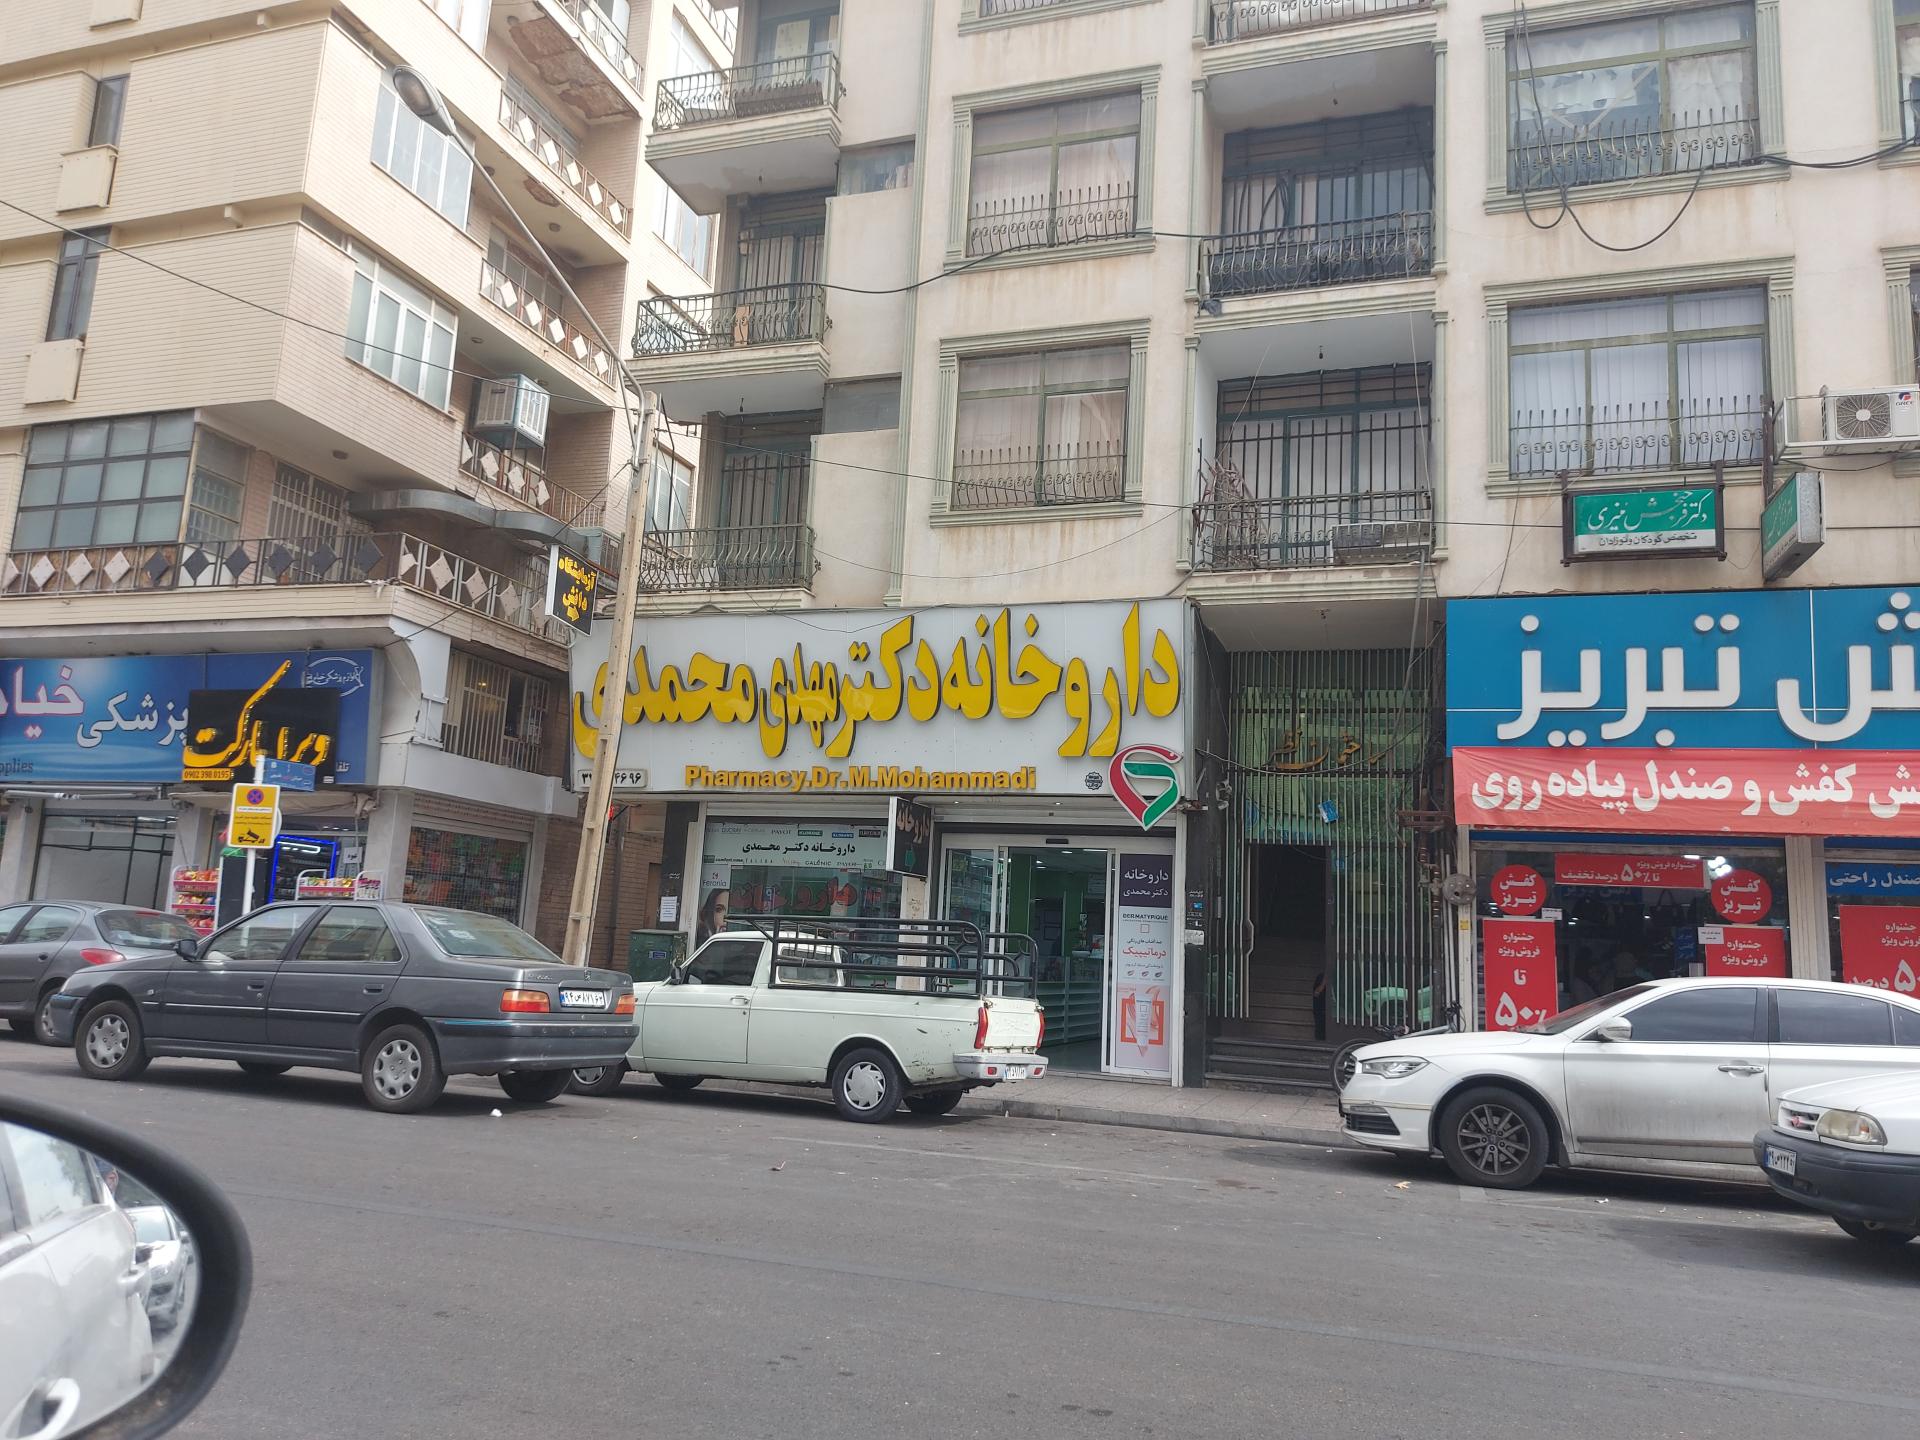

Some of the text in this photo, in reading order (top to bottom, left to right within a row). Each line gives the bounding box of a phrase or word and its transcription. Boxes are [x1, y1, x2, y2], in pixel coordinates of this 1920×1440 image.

[825, 615, 941, 758] دکتر
[942, 601, 1180, 758] داروخانه
[1497, 613, 1741, 747] تبریز
[1471, 771, 1543, 812] روی
[1547, 760, 1626, 814] پیاده
[1632, 760, 1733, 812] صندل
[1768, 761, 1857, 816] کفش
[1741, 779, 1762, 816] و
[742, 842, 856, 856] داروخانه دکتر محمدی
[1124, 867, 1169, 884] داروخانه
[1500, 873, 1536, 890] کفش
[1829, 872, 1876, 888] راحتی
[1123, 888, 1169, 898] دکتر محمدی
[1720, 878, 1760, 896] کفش
[1500, 889, 1537, 908] تبریز
[1722, 896, 1761, 914] تبریز
[1885, 922, 1917, 934] جشنواره
[1503, 932, 1535, 943] جشنواره
[1726, 939, 1762, 950] جشنواره
[1881, 935, 1898, 948] ویژه
[1498, 946, 1540, 958] فروش ویژه
[1722, 955, 1768, 967] فروش ویژه
[1513, 969, 1527, 986] تا
